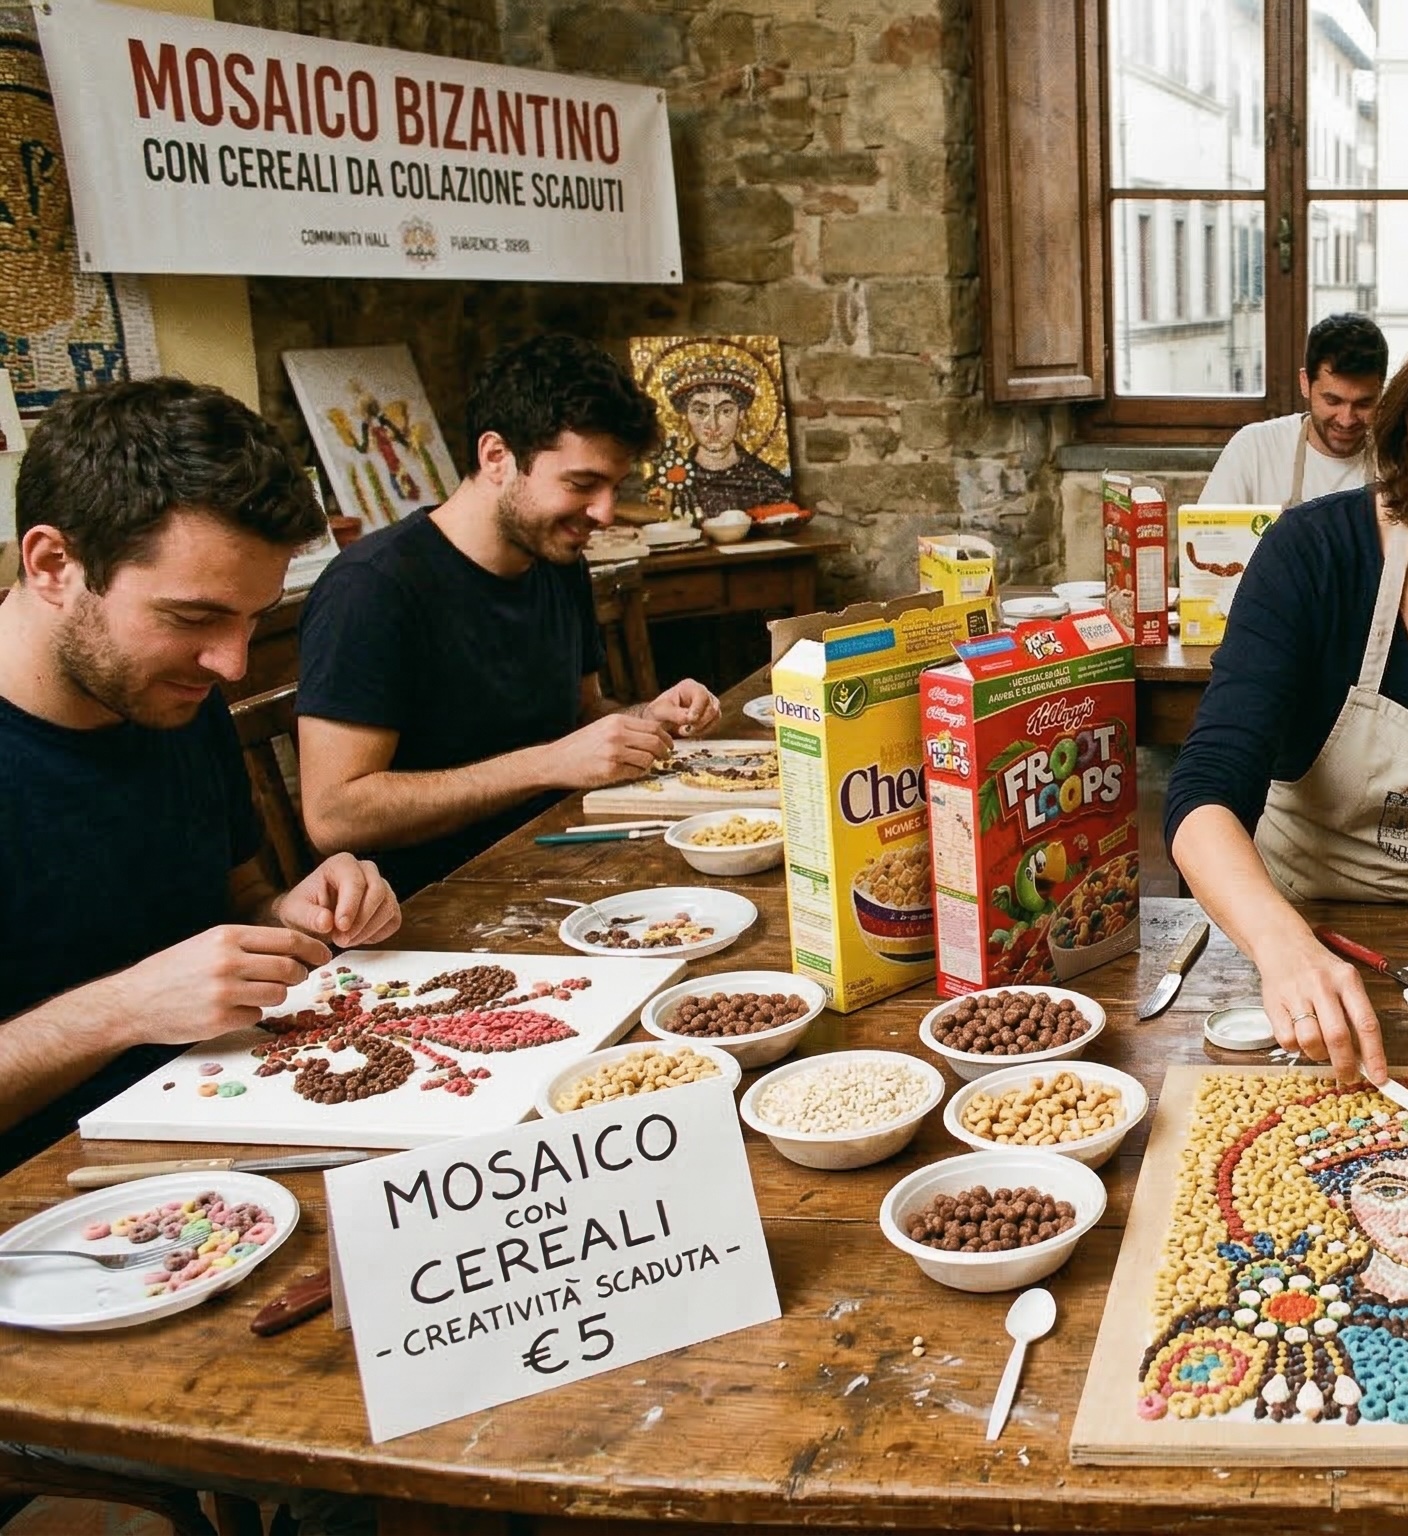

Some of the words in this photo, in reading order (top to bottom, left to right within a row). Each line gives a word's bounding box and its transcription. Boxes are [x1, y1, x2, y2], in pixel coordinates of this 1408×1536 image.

[128, 38, 379, 142] MOSAICO
[395, 76, 620, 165] BIZANTINO
[143, 138, 210, 185] CON
[218, 145, 339, 194] CEREALI
[346, 156, 384, 198] DA
[391, 160, 527, 206] COLAZIONE
[531, 172, 624, 213] SCADUTI
[1004, 725, 1116, 808] FROOT
[1024, 764, 1123, 830] LOOPS
[383, 1113, 678, 1230] MOSAICO
[505, 1196, 568, 1229] CON
[410, 1199, 671, 1304] CEREALI
[402, 1278, 582, 1356] CREATIVITÀ
[596, 1243, 720, 1299] SCADUTA
[521, 1312, 615, 1375] €5
